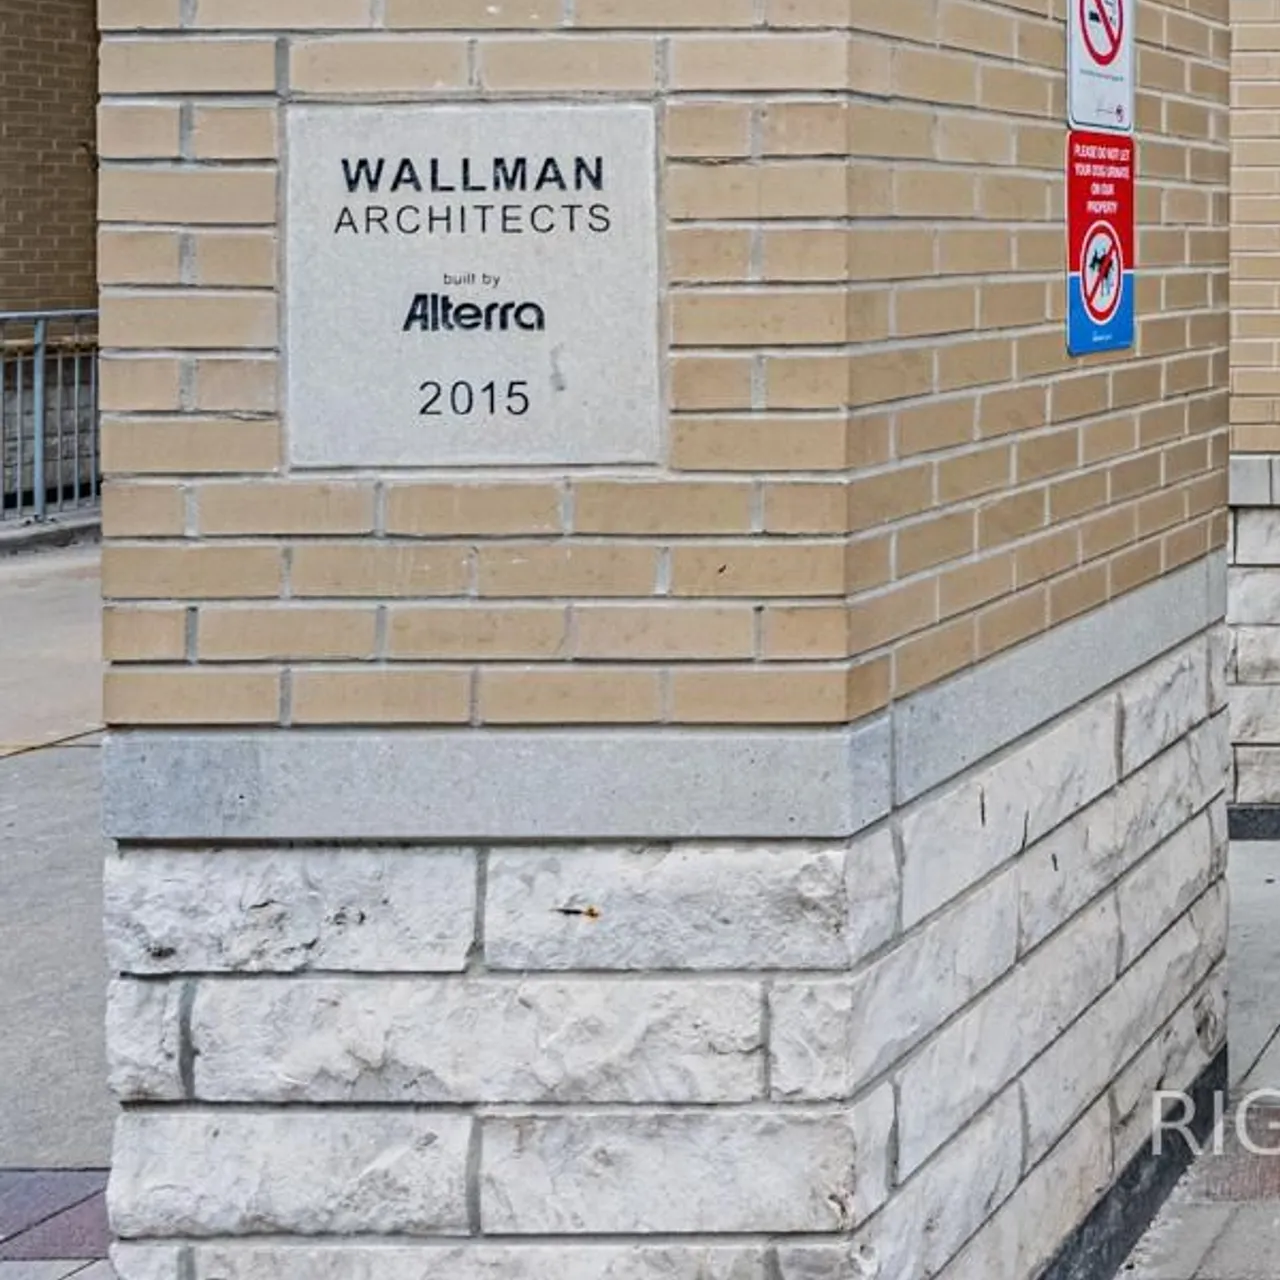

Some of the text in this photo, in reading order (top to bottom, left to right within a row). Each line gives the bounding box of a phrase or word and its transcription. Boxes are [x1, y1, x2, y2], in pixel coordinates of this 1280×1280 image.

[340, 156, 604, 193] WALLMAN
[334, 203, 612, 235] ARCHITECTS
[443, 272, 501, 288] built by
[402, 293, 545, 332] Alterra
[418, 380, 530, 416] 2015
